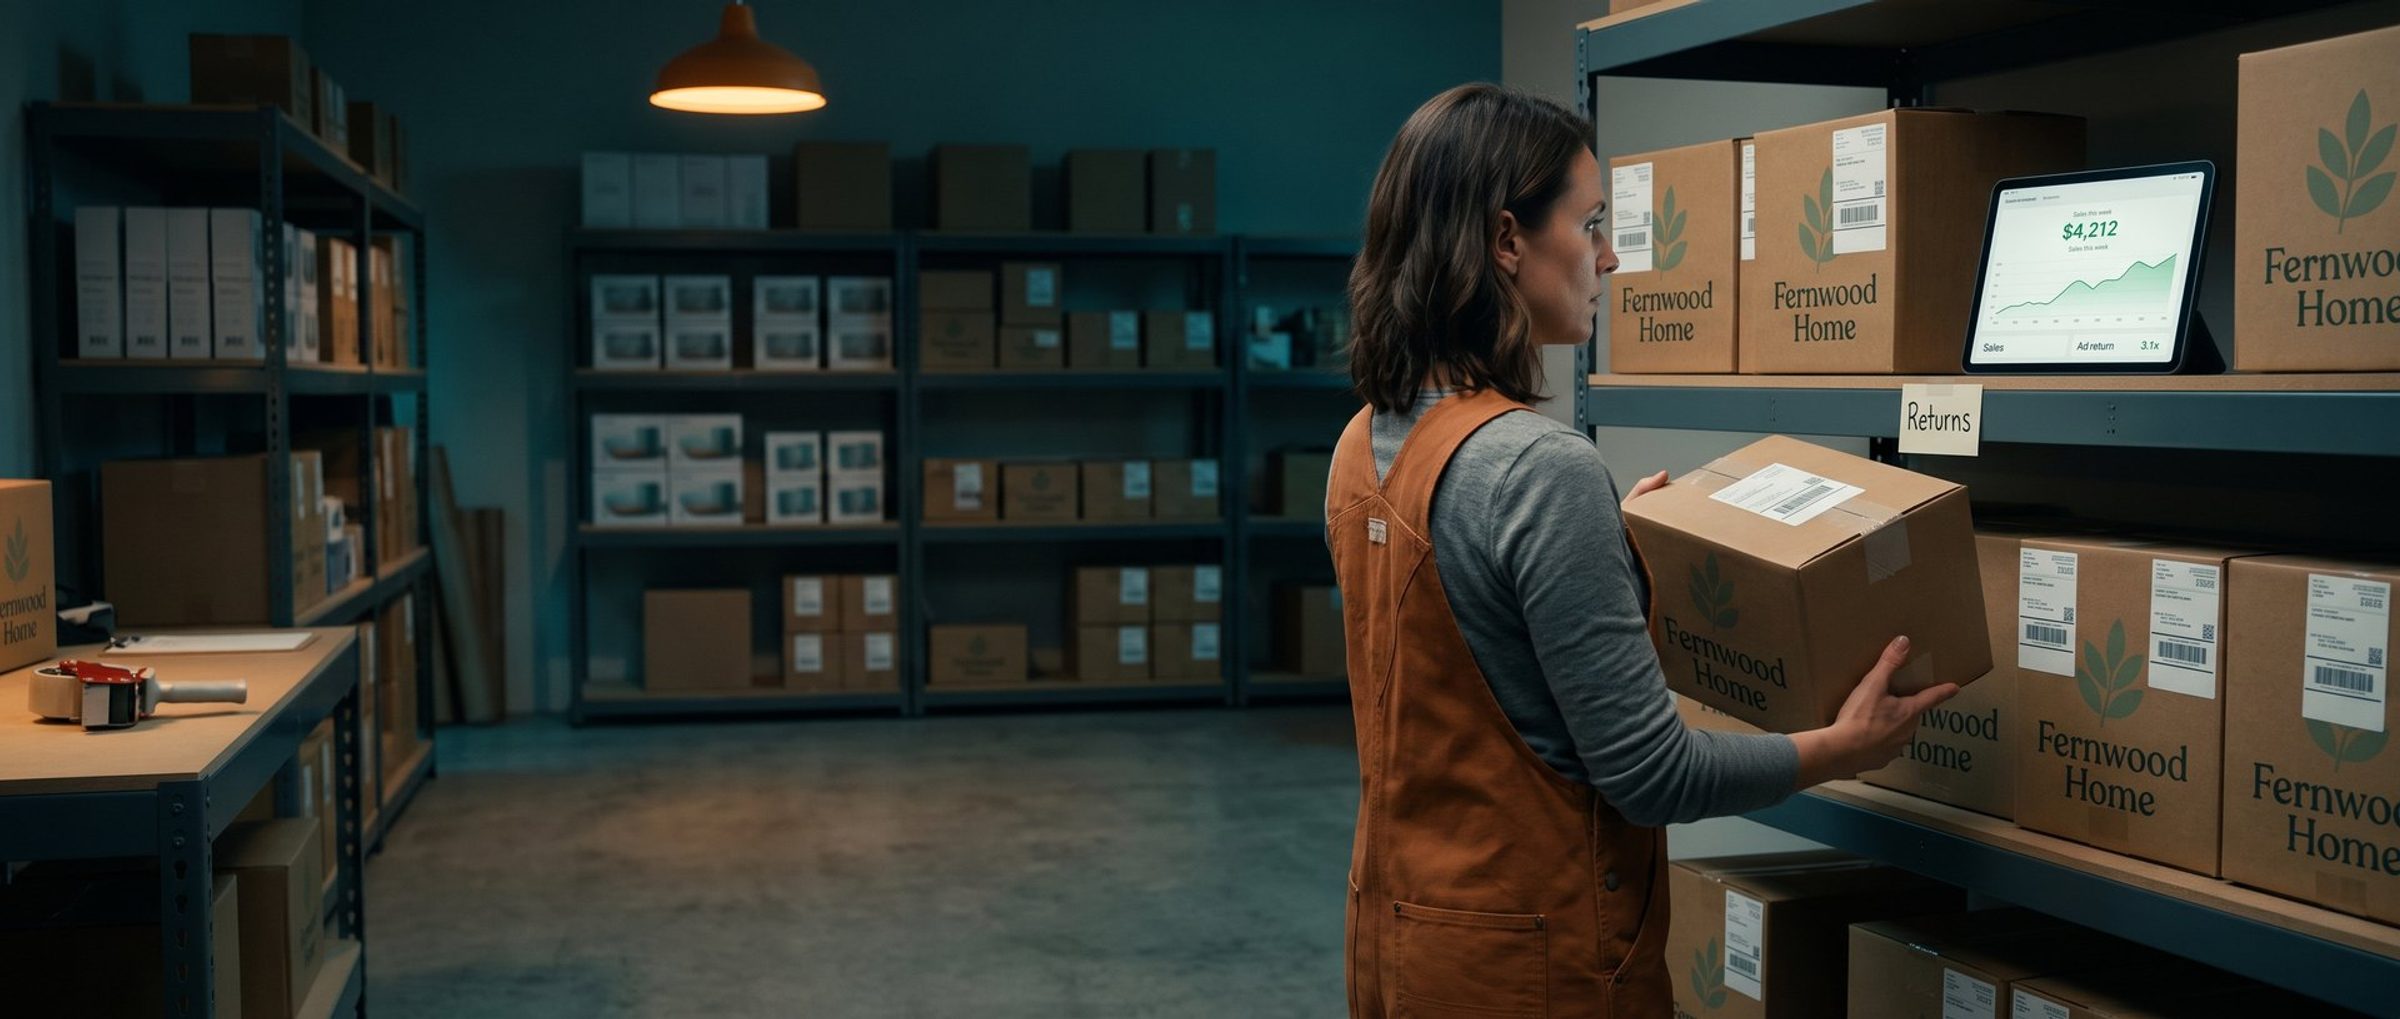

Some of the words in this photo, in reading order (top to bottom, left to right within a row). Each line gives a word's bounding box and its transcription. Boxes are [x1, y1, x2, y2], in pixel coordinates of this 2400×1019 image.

[2062, 220, 2119, 242] $4,212
[2264, 247, 2400, 285] Fernwo
[1621, 280, 1713, 313] Fernwood
[1774, 273, 1877, 310] Fernwood
[2296, 289, 2400, 328] Home
[1639, 316, 1694, 342] Home
[1793, 314, 1857, 342] Home
[2076, 341, 2089, 351] Ad
[2089, 341, 2115, 351] return
[2140, 340, 2160, 351] 3.1x
[1983, 342, 2005, 353] Sales
[1908, 401, 1971, 432] Returns
[0, 585, 46, 618] ernwood
[4, 620, 37, 645] Home
[1664, 616, 1787, 689] Fernwood
[1692, 657, 1768, 711] Home
[2038, 719, 2188, 782] Fernwood
[2065, 765, 2155, 816] Home
[2252, 762, 2400, 829] Fernwo
[2287, 814, 2400, 876] Home
